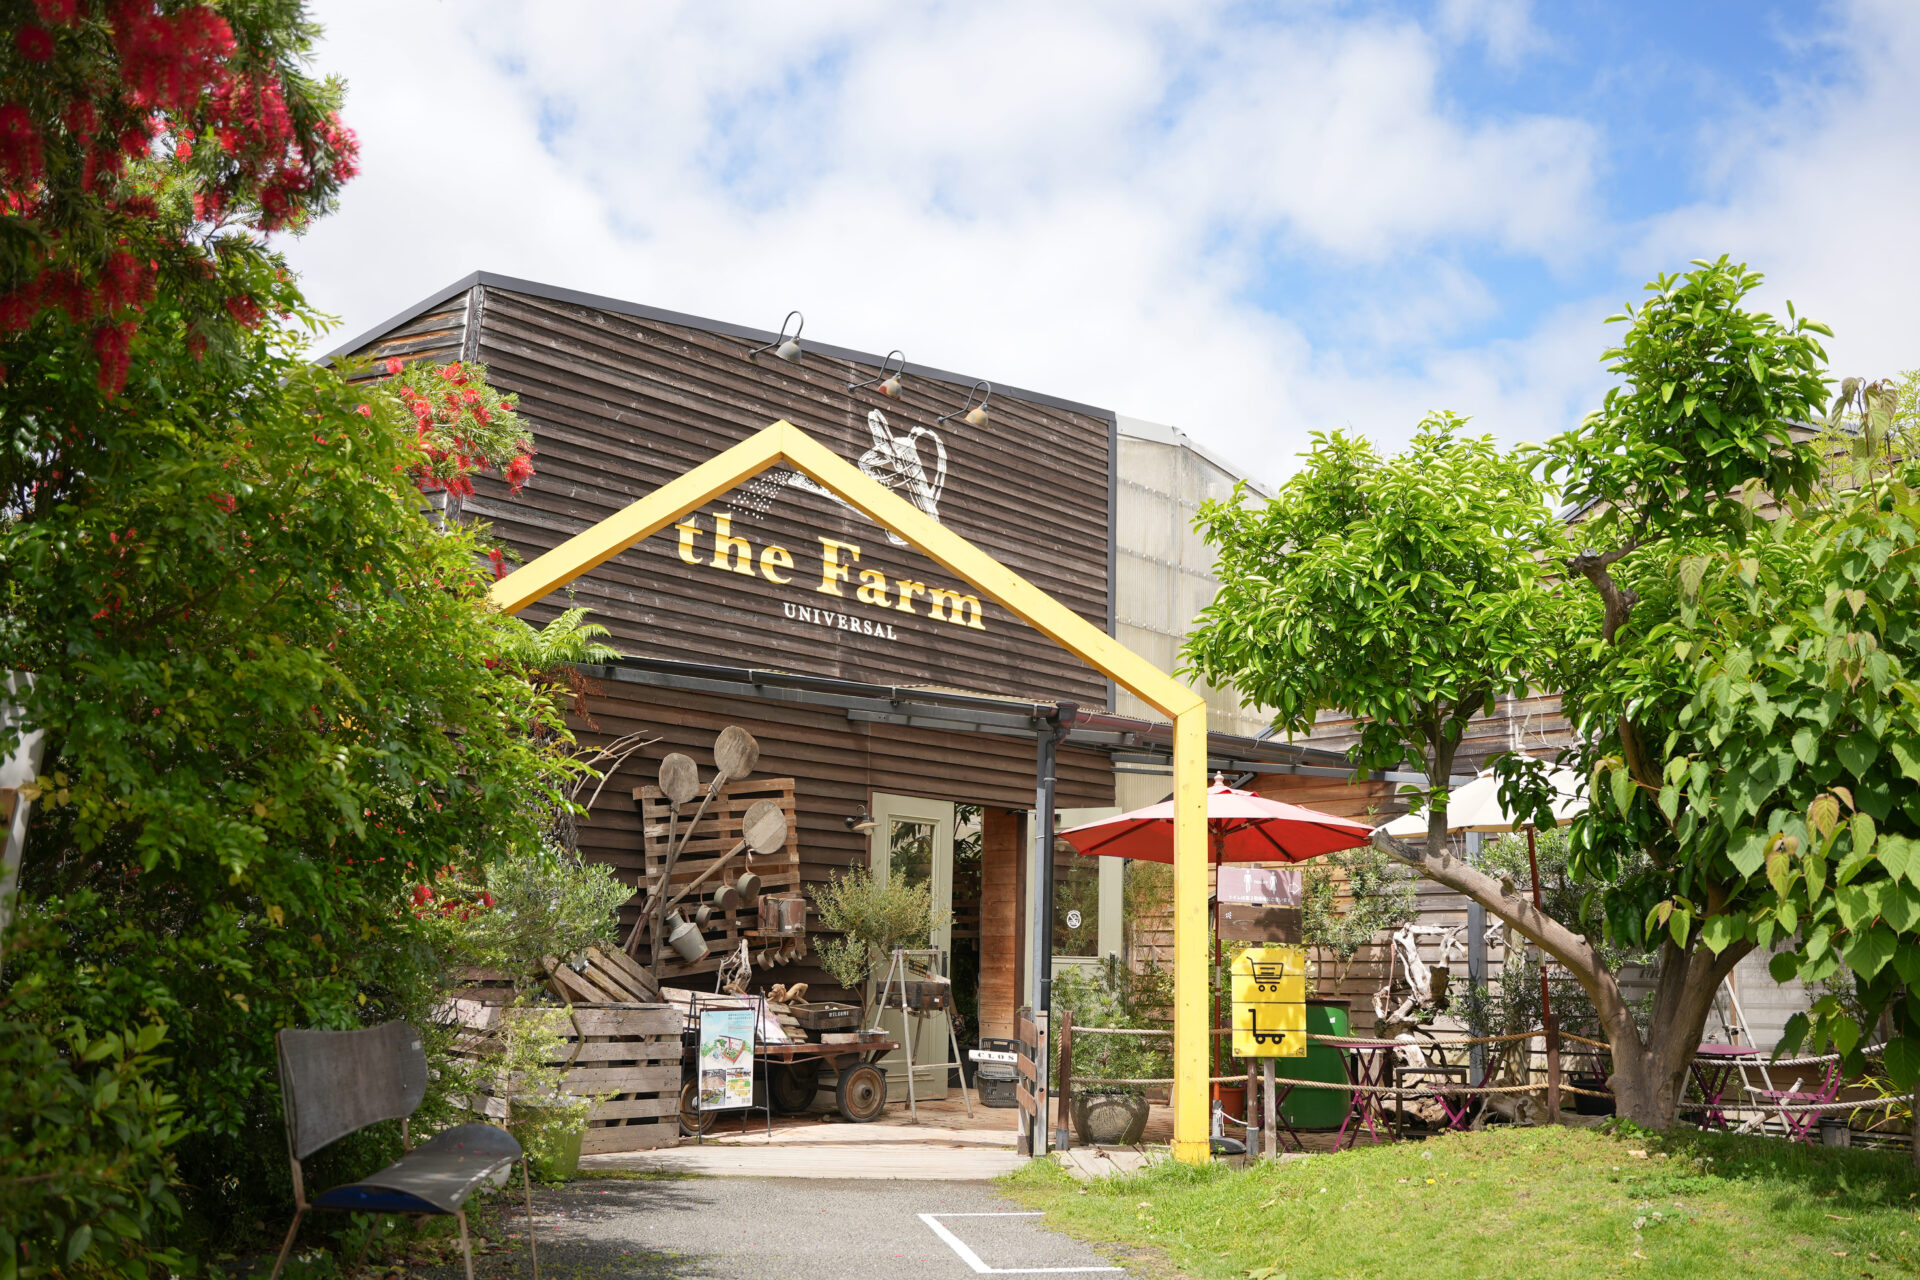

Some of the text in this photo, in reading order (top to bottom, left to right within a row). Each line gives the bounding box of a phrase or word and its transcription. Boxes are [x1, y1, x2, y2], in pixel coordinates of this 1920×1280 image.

[675, 511, 986, 631] the Farm
[783, 602, 898, 640] UNIVERSAL
